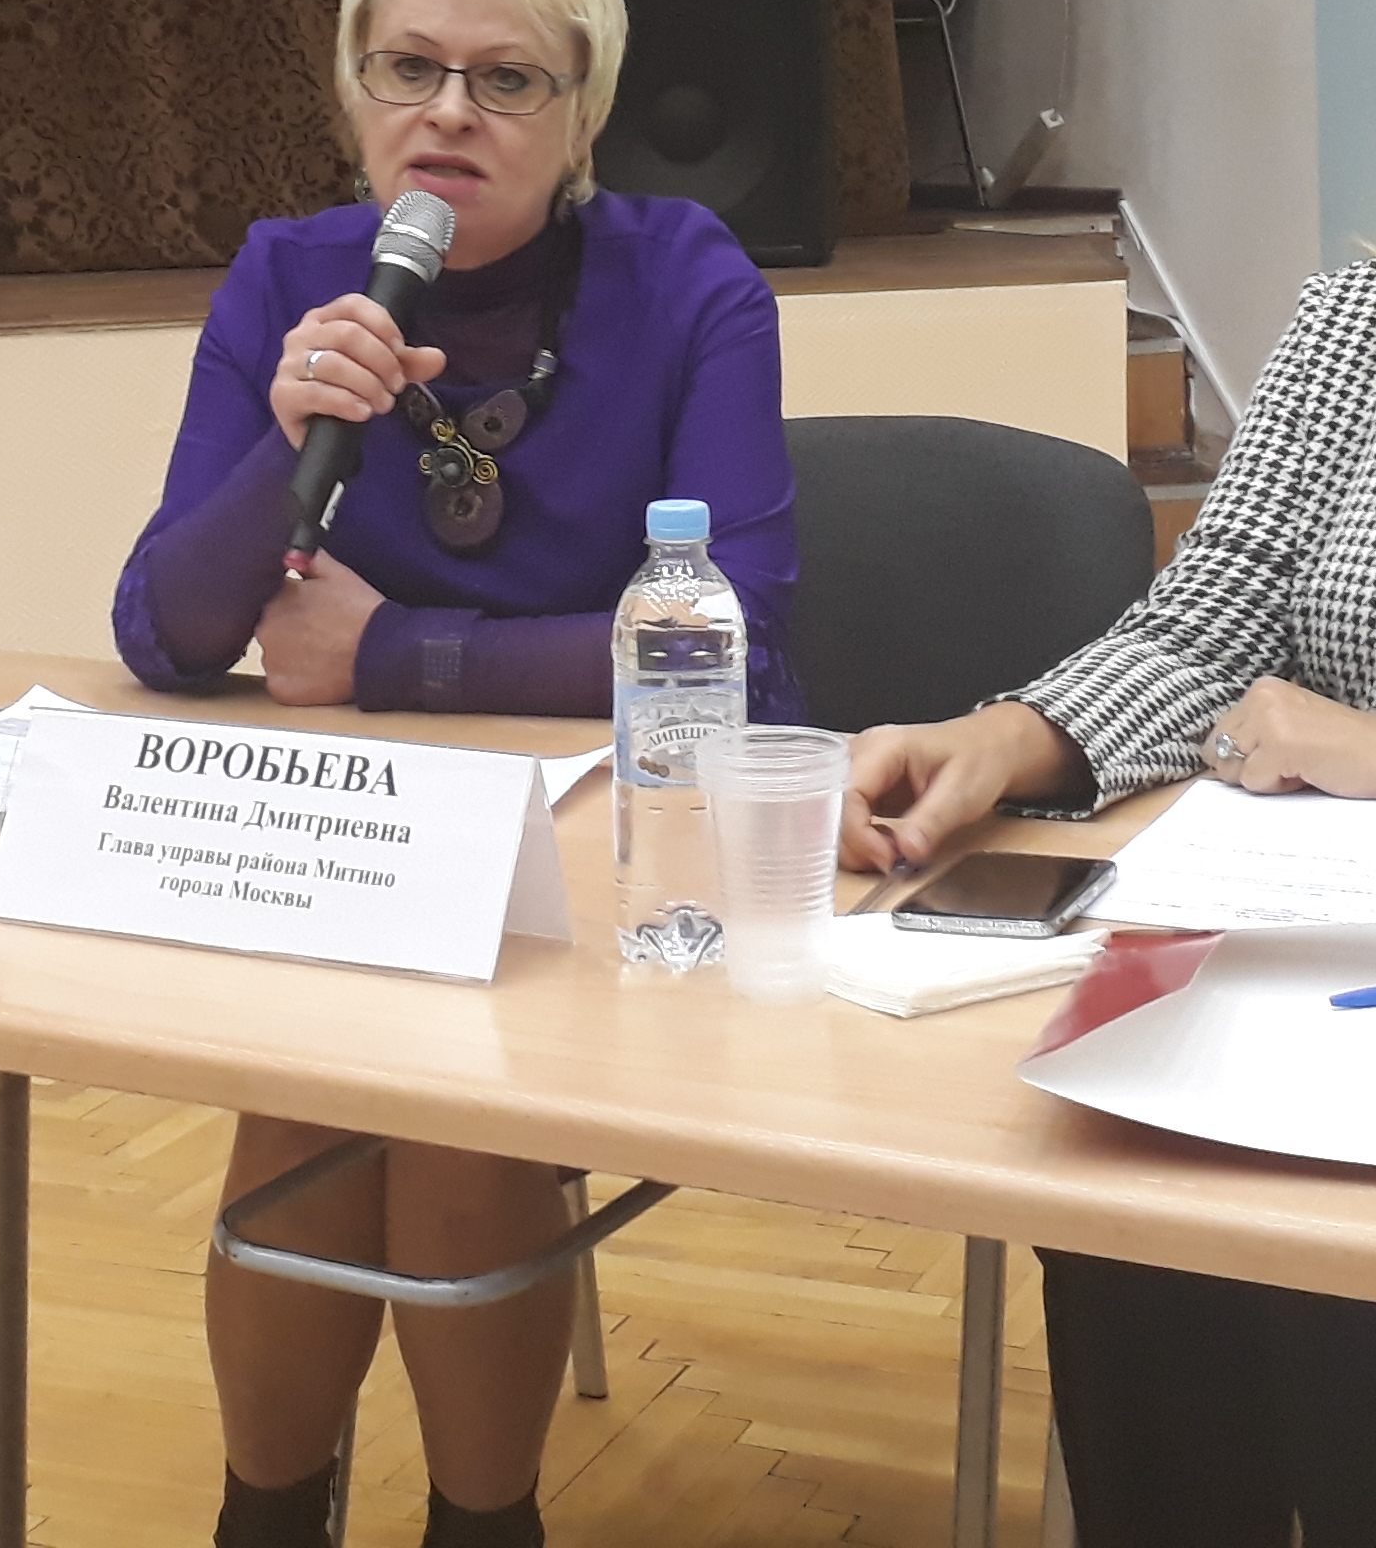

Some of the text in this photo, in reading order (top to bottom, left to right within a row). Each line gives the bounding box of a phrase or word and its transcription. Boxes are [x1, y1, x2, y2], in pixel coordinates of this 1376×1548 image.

[135, 733, 398, 796] ВОРОБЬЕВА
[103, 784, 411, 845] Валентина Дмитриевна
[97, 831, 395, 888] Глава управы района Митино
[159, 875, 312, 910] города Москвы
